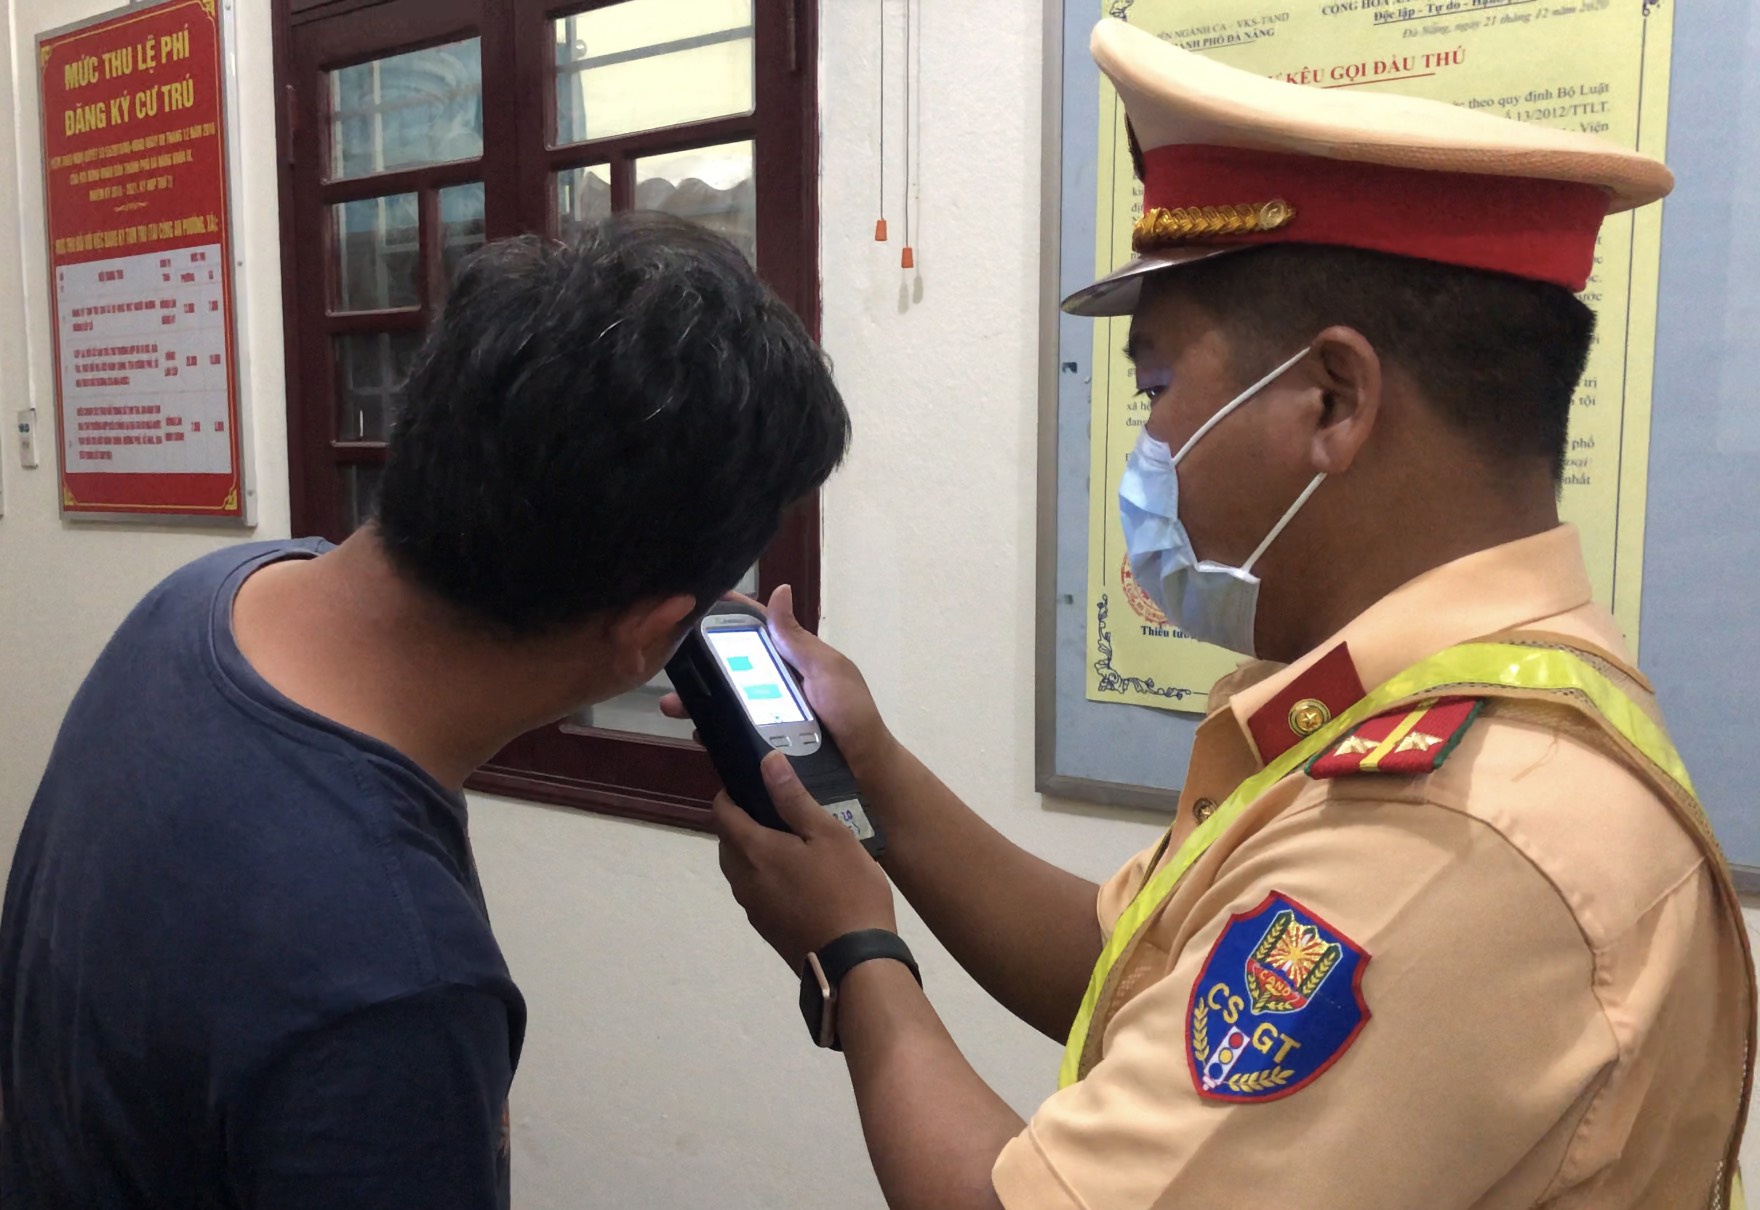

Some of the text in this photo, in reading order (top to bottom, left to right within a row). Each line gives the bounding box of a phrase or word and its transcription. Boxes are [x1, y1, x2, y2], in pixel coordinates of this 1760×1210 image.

[1446, 2, 1461, 10] do
[1483, 16, 1496, 27] 21
[1535, 7, 1549, 19] 12
[64, 23, 190, 90] MỨC THU LỆ PHÍ
[1286, 66, 1324, 85] KÊU
[1330, 62, 1366, 82] GỌI
[1422, 45, 1466, 68] THÚ
[64, 73, 194, 137] ĐĂNG KÝ CƯ TRÚ
[1468, 98, 1495, 109] theo
[1498, 95, 1521, 108] quy
[1525, 90, 1553, 103] định
[1557, 86, 1575, 98] Bộ
[1260, 970, 1291, 997] CAND
[1207, 982, 1301, 1064] CS GT
